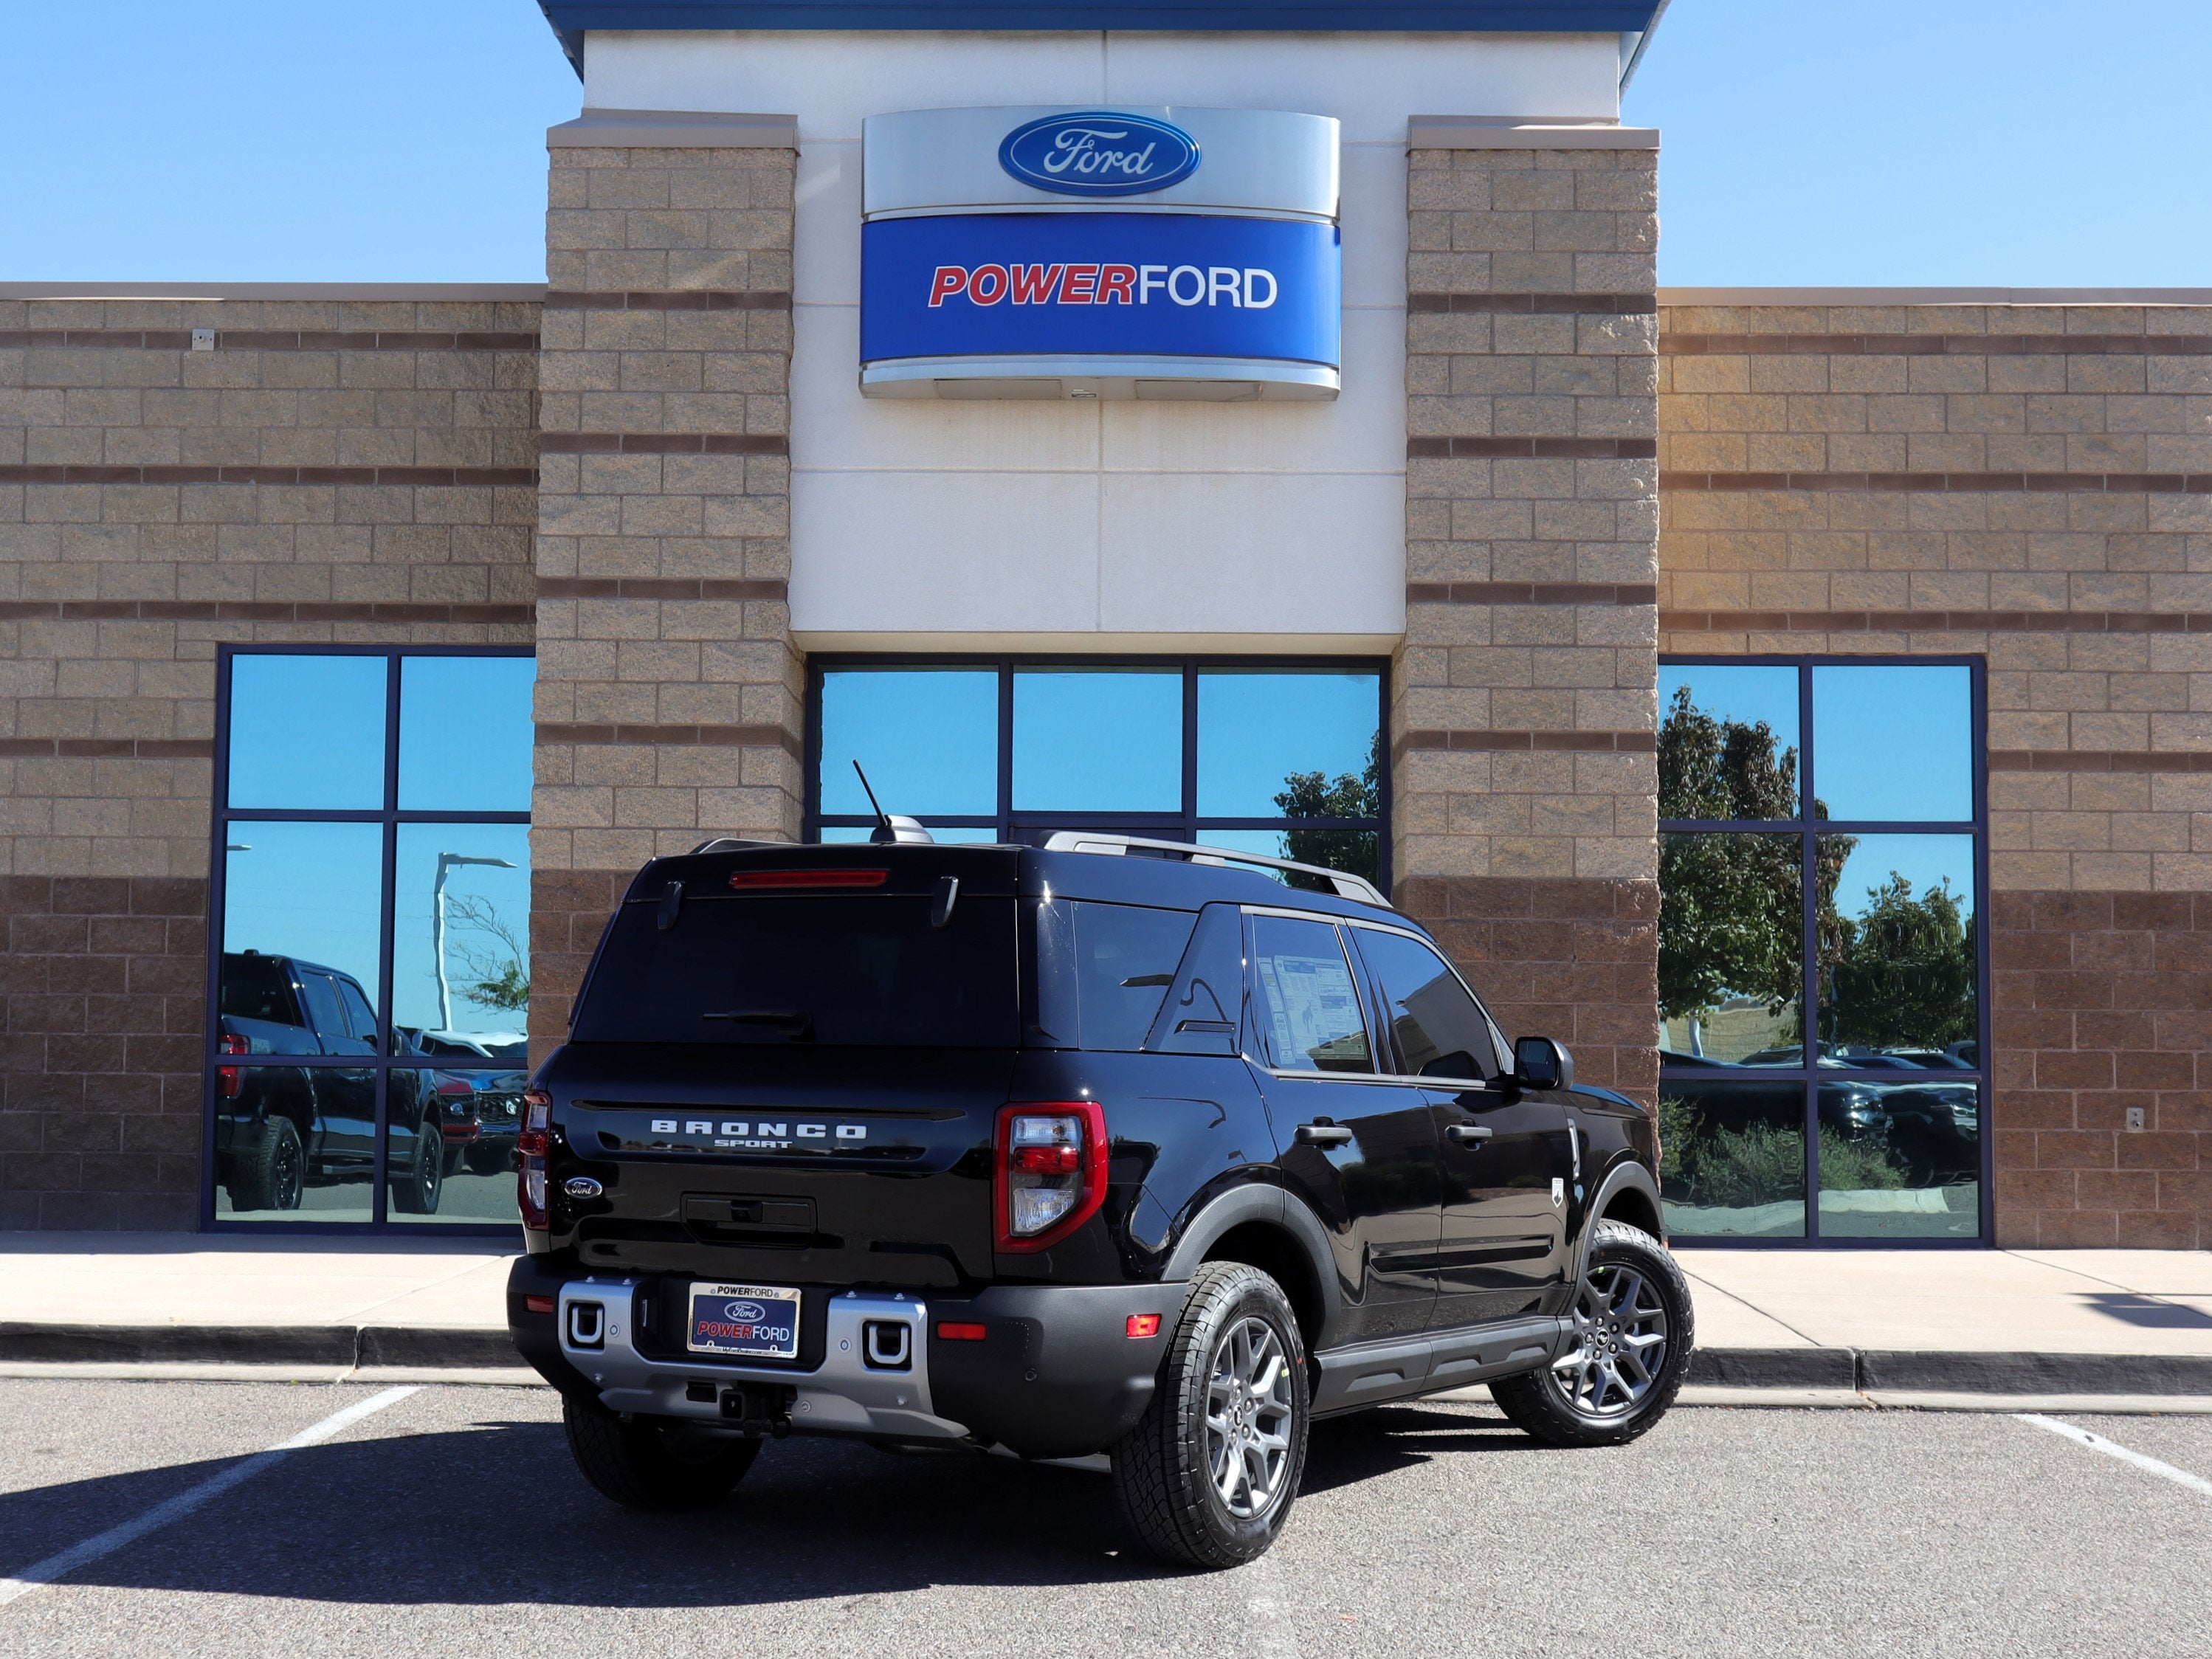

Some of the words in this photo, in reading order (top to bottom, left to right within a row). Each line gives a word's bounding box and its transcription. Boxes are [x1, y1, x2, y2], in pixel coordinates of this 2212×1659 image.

[1044, 128, 1157, 176] Ford
[927, 263, 1278, 309] POWERFORD
[651, 1120, 867, 1139] BRONCO
[714, 1139, 793, 1149] SPORT
[571, 1181, 593, 1195] Ford
[732, 1305, 757, 1318] Ford
